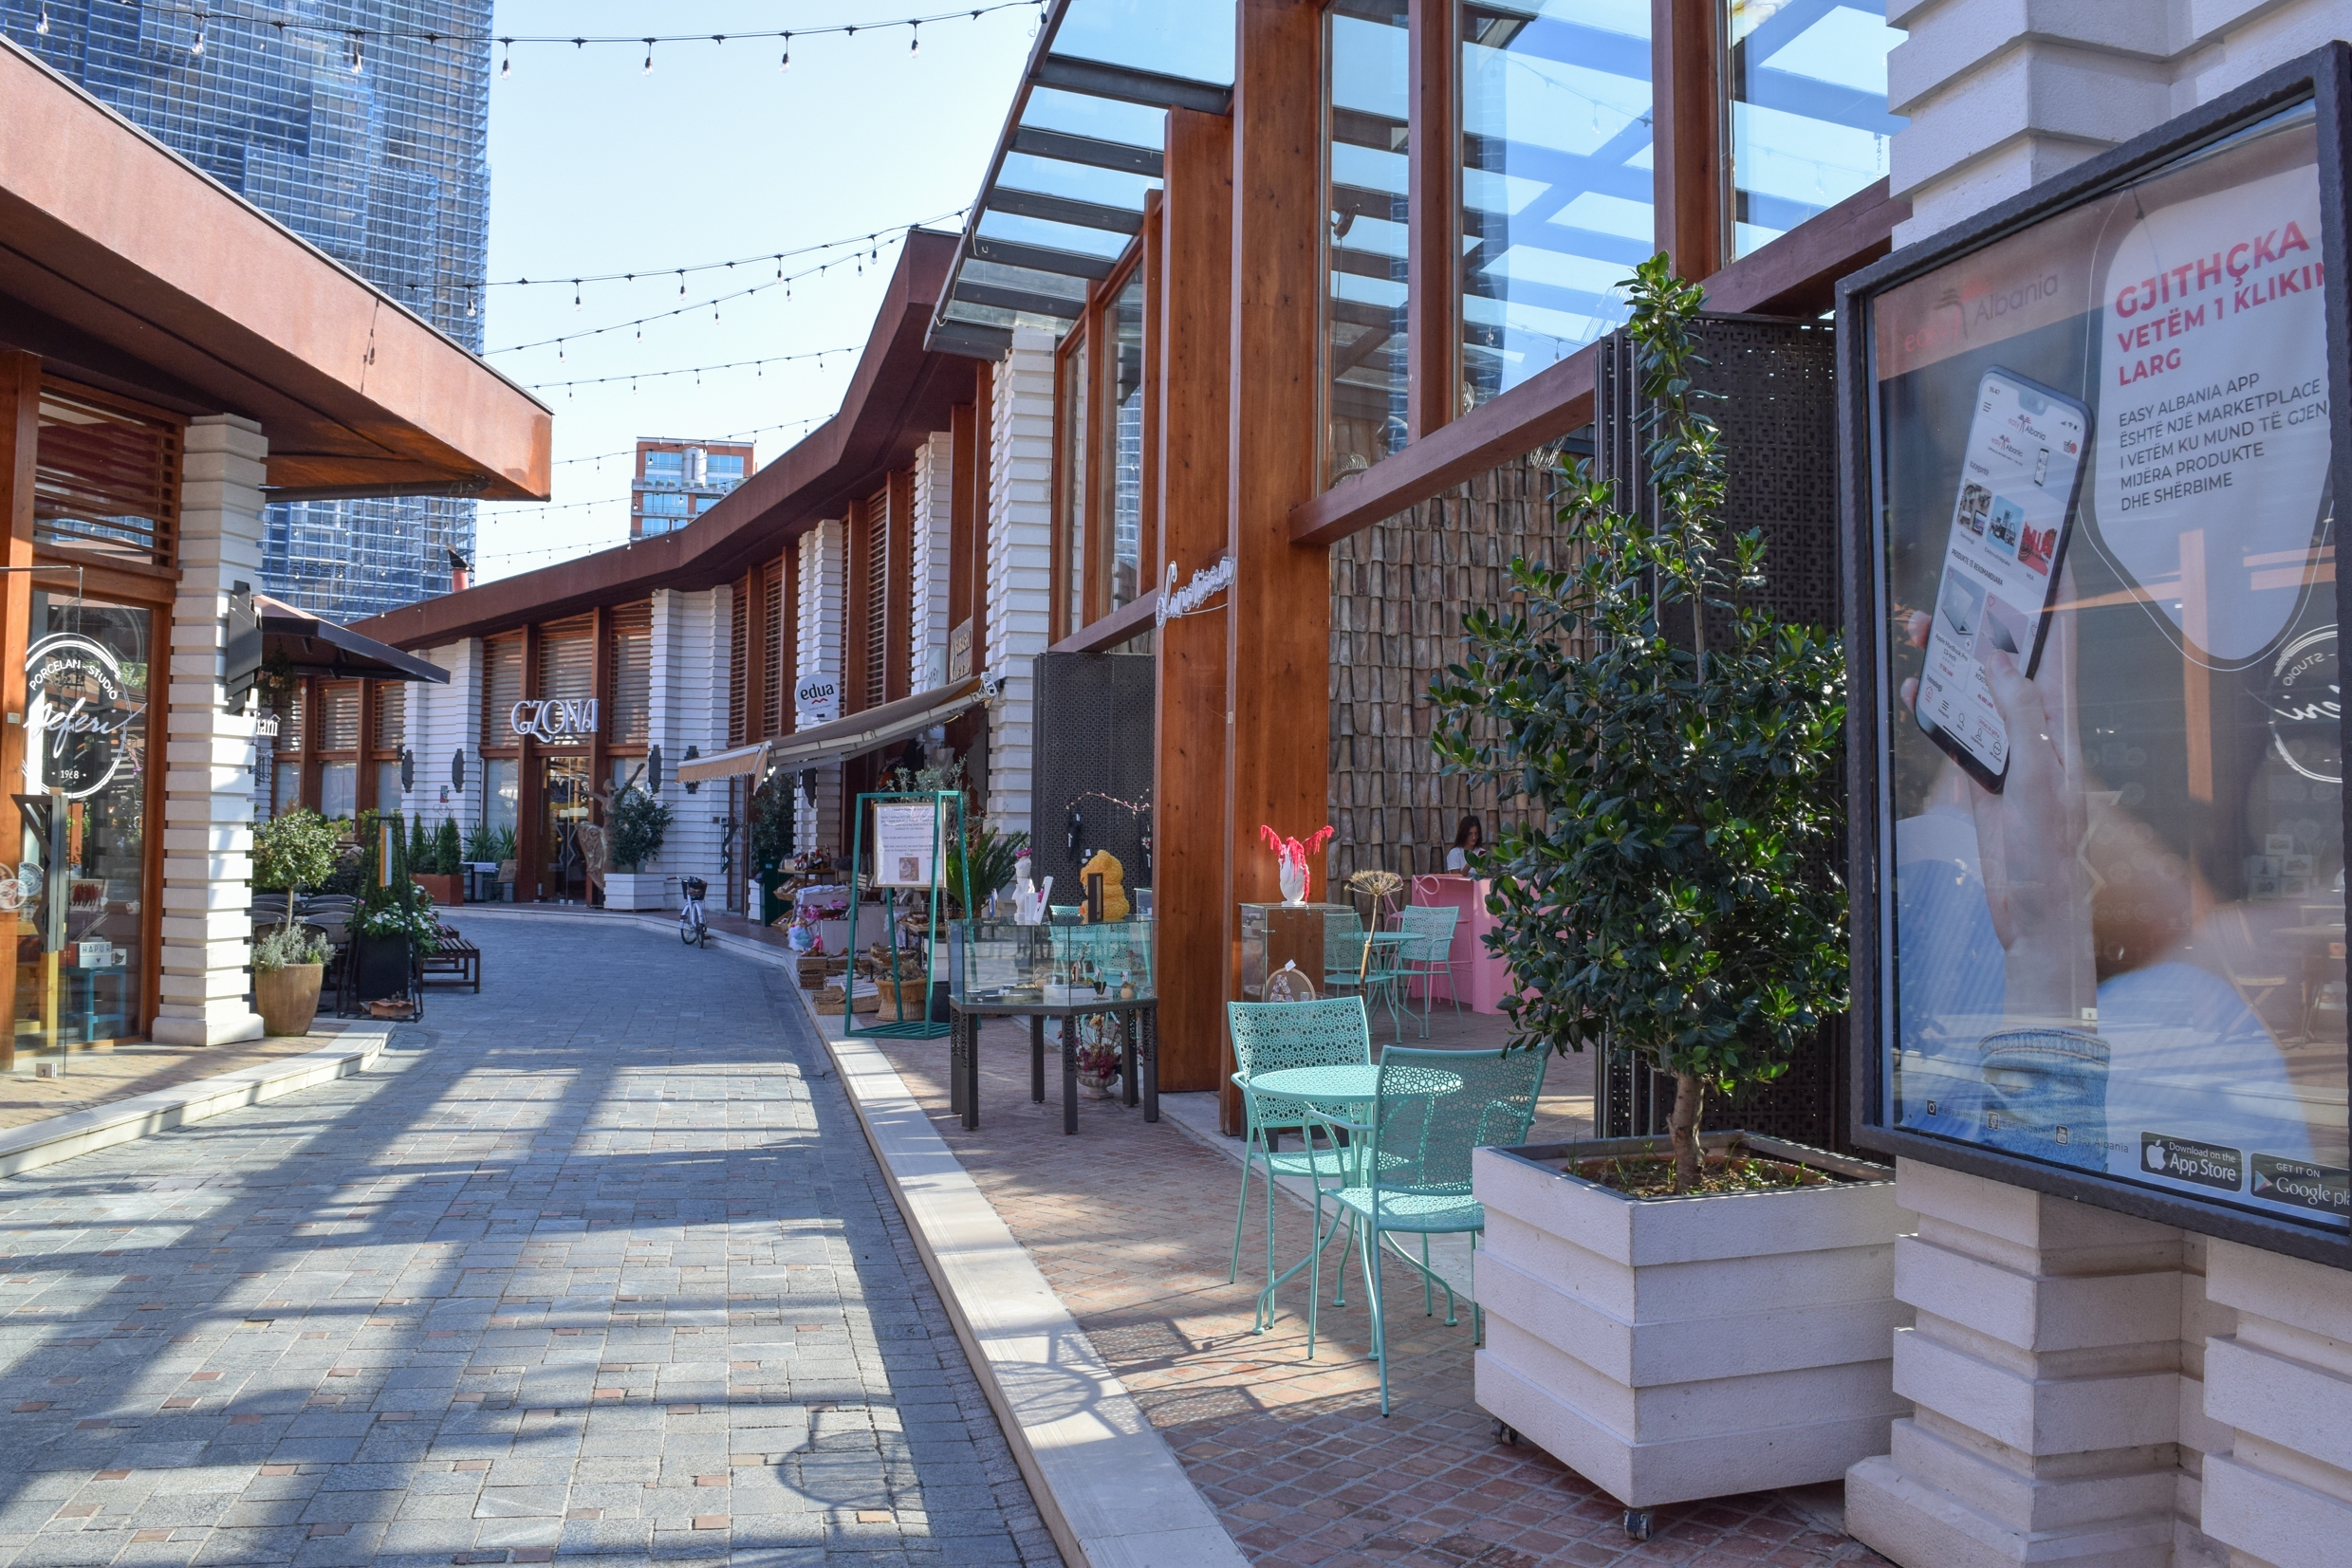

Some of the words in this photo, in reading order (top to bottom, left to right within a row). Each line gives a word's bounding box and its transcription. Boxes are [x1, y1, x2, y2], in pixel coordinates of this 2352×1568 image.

[2116, 220, 2310, 319] GJITHÇKA
[1974, 272, 2059, 326] Albania
[2117, 304, 2205, 353] VETËM
[2213, 297, 2224, 321] 1
[2119, 347, 2181, 386] LARG
[2119, 404, 2155, 428] EASY
[2158, 383, 2222, 416] ALBANIA
[2226, 372, 2260, 396] APP
[2120, 421, 2163, 449] ËSHTË
[2167, 412, 2195, 435] NJË
[2197, 378, 2321, 426] MARKETPLACE
[2120, 456, 2124, 470] I
[2127, 441, 2174, 468] VETËM
[2177, 434, 2199, 453] KU
[2204, 421, 2254, 447] MUND
[2258, 412, 2283, 433] TË
[2287, 400, 2327, 426] GJEN
[2121, 465, 2173, 490] MIJËRA
[2176, 441, 2265, 476] PRODUKTE
[2121, 491, 2151, 511] DHE
[2155, 471, 2233, 504] SHËRBIME
[28, 658, 82, 691] PORCELAN
[87, 665, 118, 700] STUDIO
[800, 683, 835, 701] edua
[510, 698, 599, 743] GZONA
[82, 944, 111, 953] HAPUR
[2095, 1136, 2130, 1153] Albania
[2169, 1141, 2209, 1159] Download
[2210, 1152, 2221, 1160] on
[2222, 1152, 2236, 1163] the
[2169, 1153, 2198, 1176] App
[2199, 1159, 2236, 1182] Store
[2276, 1162, 2293, 1173] GET
[2295, 1165, 2304, 1174] IT
[2306, 1168, 2321, 1178] ON
[2276, 1176, 2331, 1206] Google
